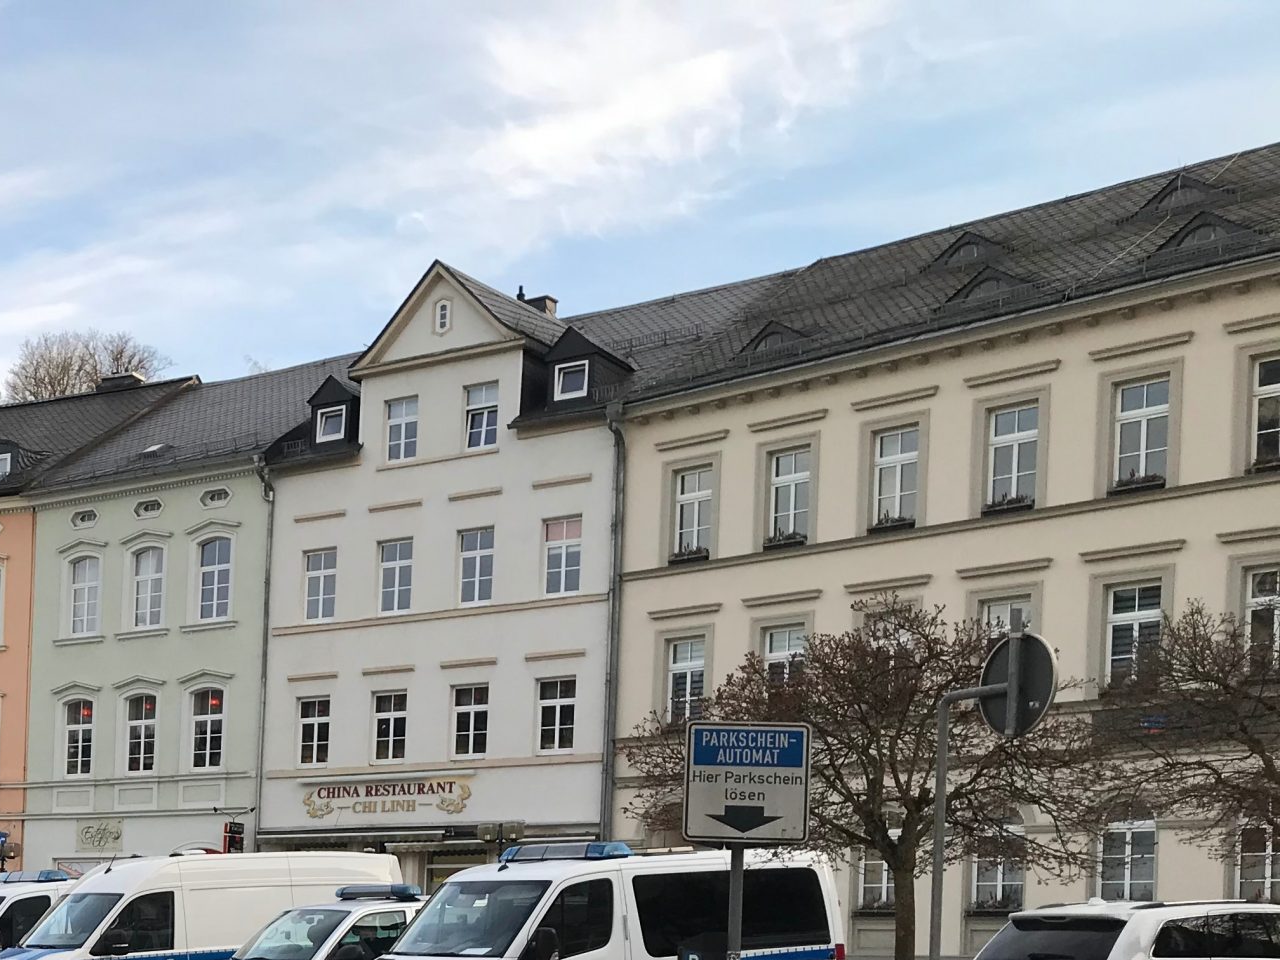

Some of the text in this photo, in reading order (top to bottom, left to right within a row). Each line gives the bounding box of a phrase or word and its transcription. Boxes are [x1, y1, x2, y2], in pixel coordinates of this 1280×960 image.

[702, 731, 797, 748] PARKSCHEIN-
[716, 749, 780, 764] AUTOMAT
[692, 770, 803, 785] Hier Parkschein
[317, 781, 456, 799] CHINA RESTAURANT
[725, 788, 766, 801] lösen
[352, 799, 416, 814] CHI LINH
